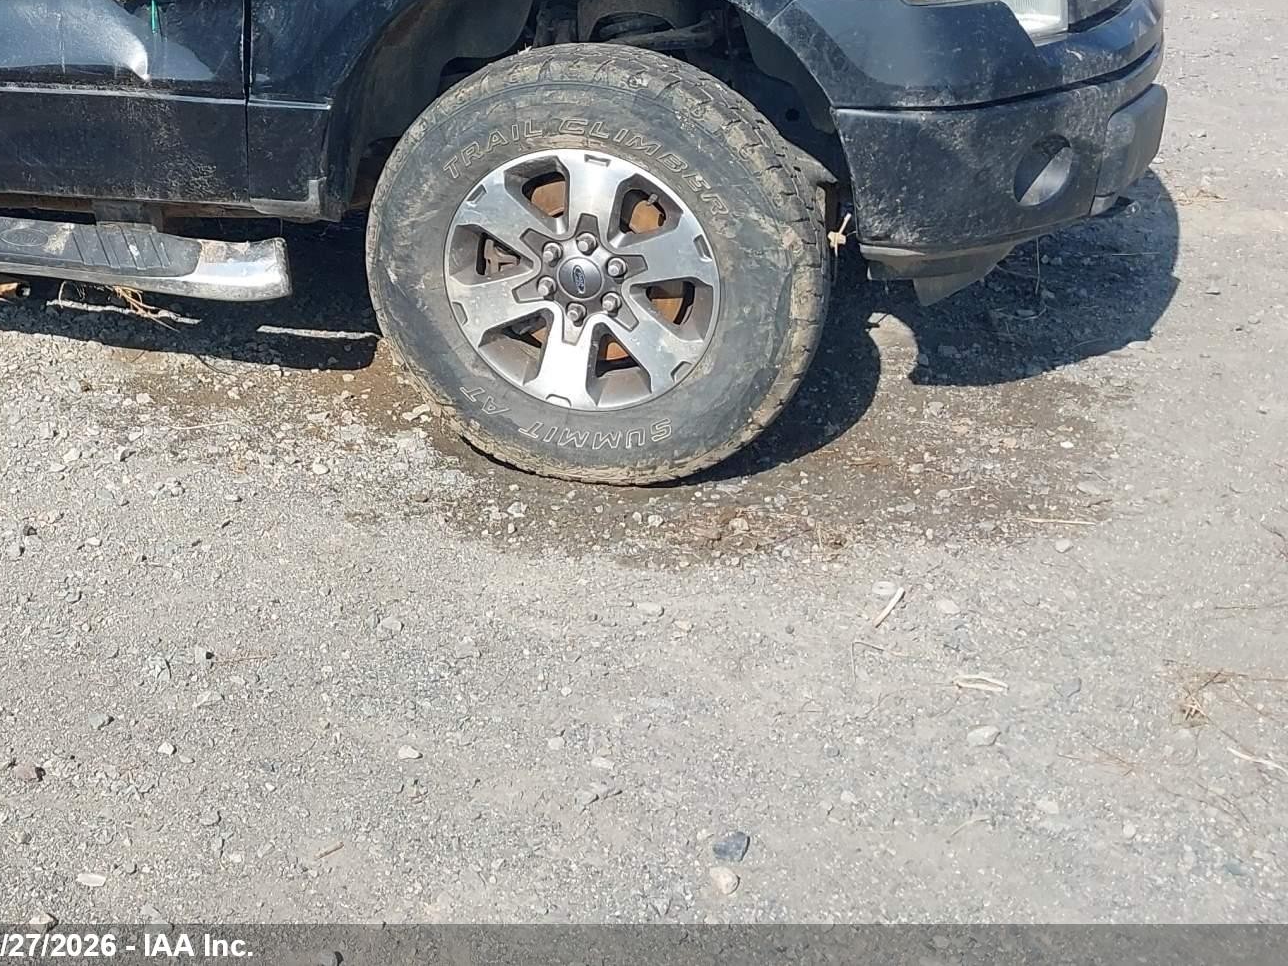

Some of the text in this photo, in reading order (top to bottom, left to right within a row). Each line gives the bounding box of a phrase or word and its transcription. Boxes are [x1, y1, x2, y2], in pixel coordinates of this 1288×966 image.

[443, 118, 730, 216] TRAIL CLIMBER
[518, 417, 672, 450] SUMMIT
